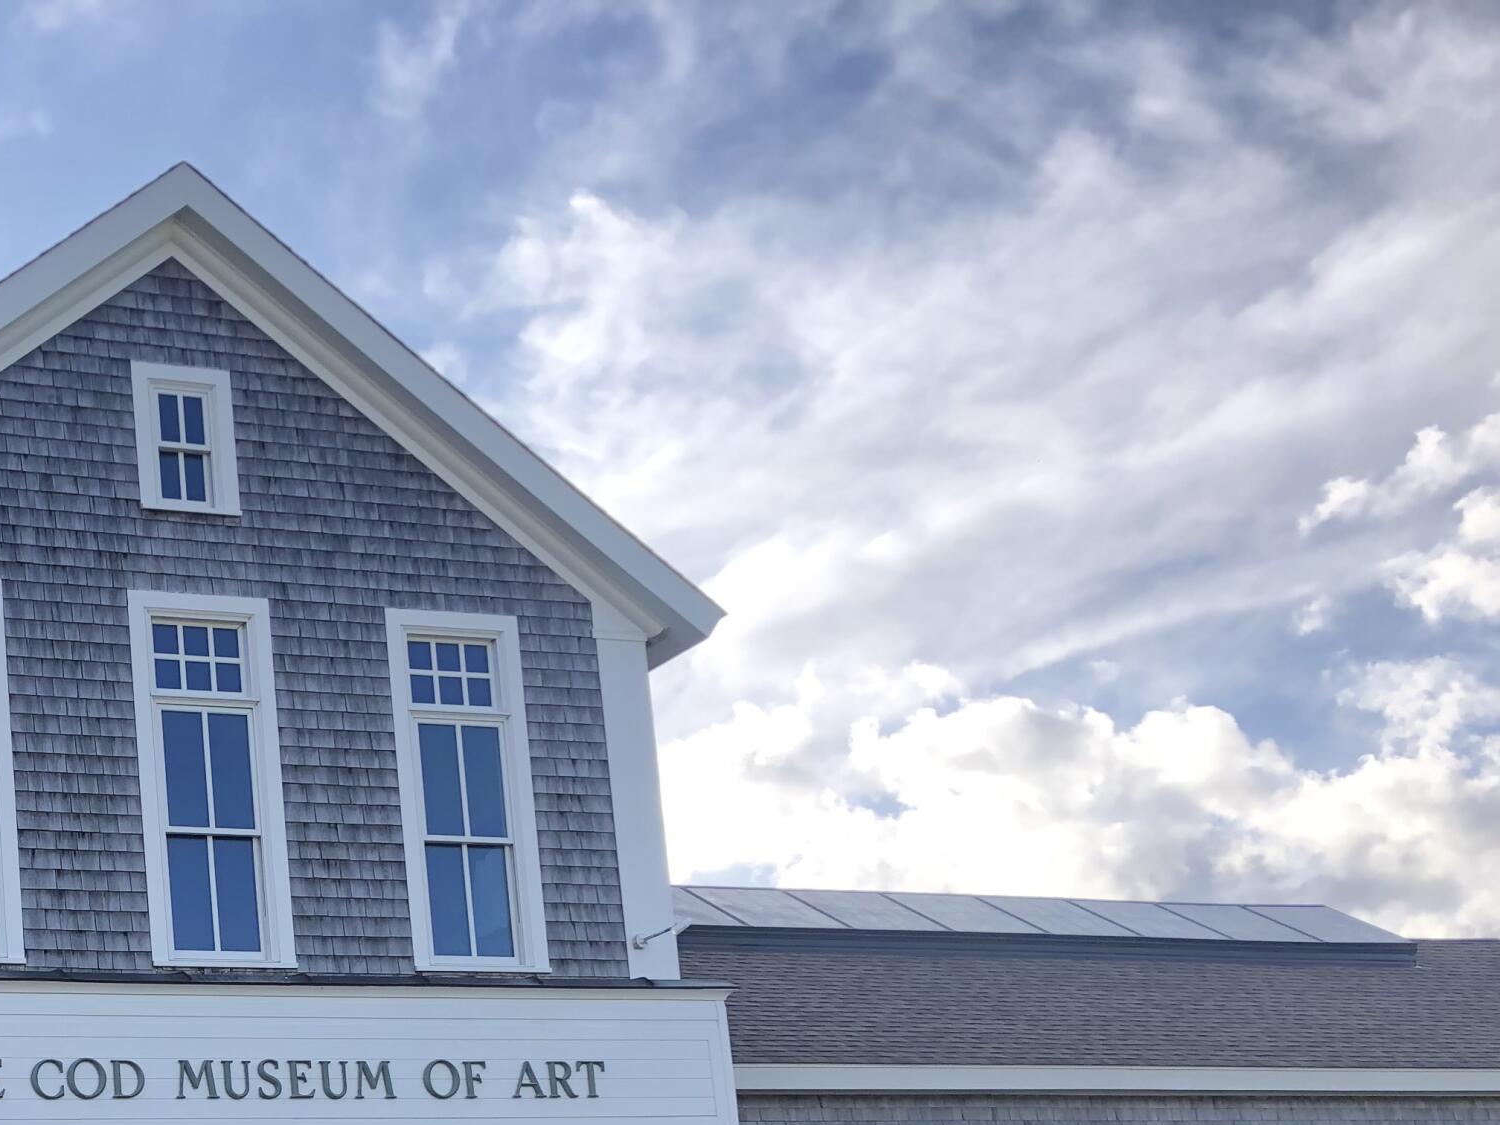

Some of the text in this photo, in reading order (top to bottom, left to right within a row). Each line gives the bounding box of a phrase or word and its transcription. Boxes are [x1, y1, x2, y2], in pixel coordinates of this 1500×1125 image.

[30, 1058, 145, 1099] COD
[176, 1059, 397, 1099] MUSEUM
[422, 1059, 486, 1099] OF
[512, 1060, 605, 1099] ART
